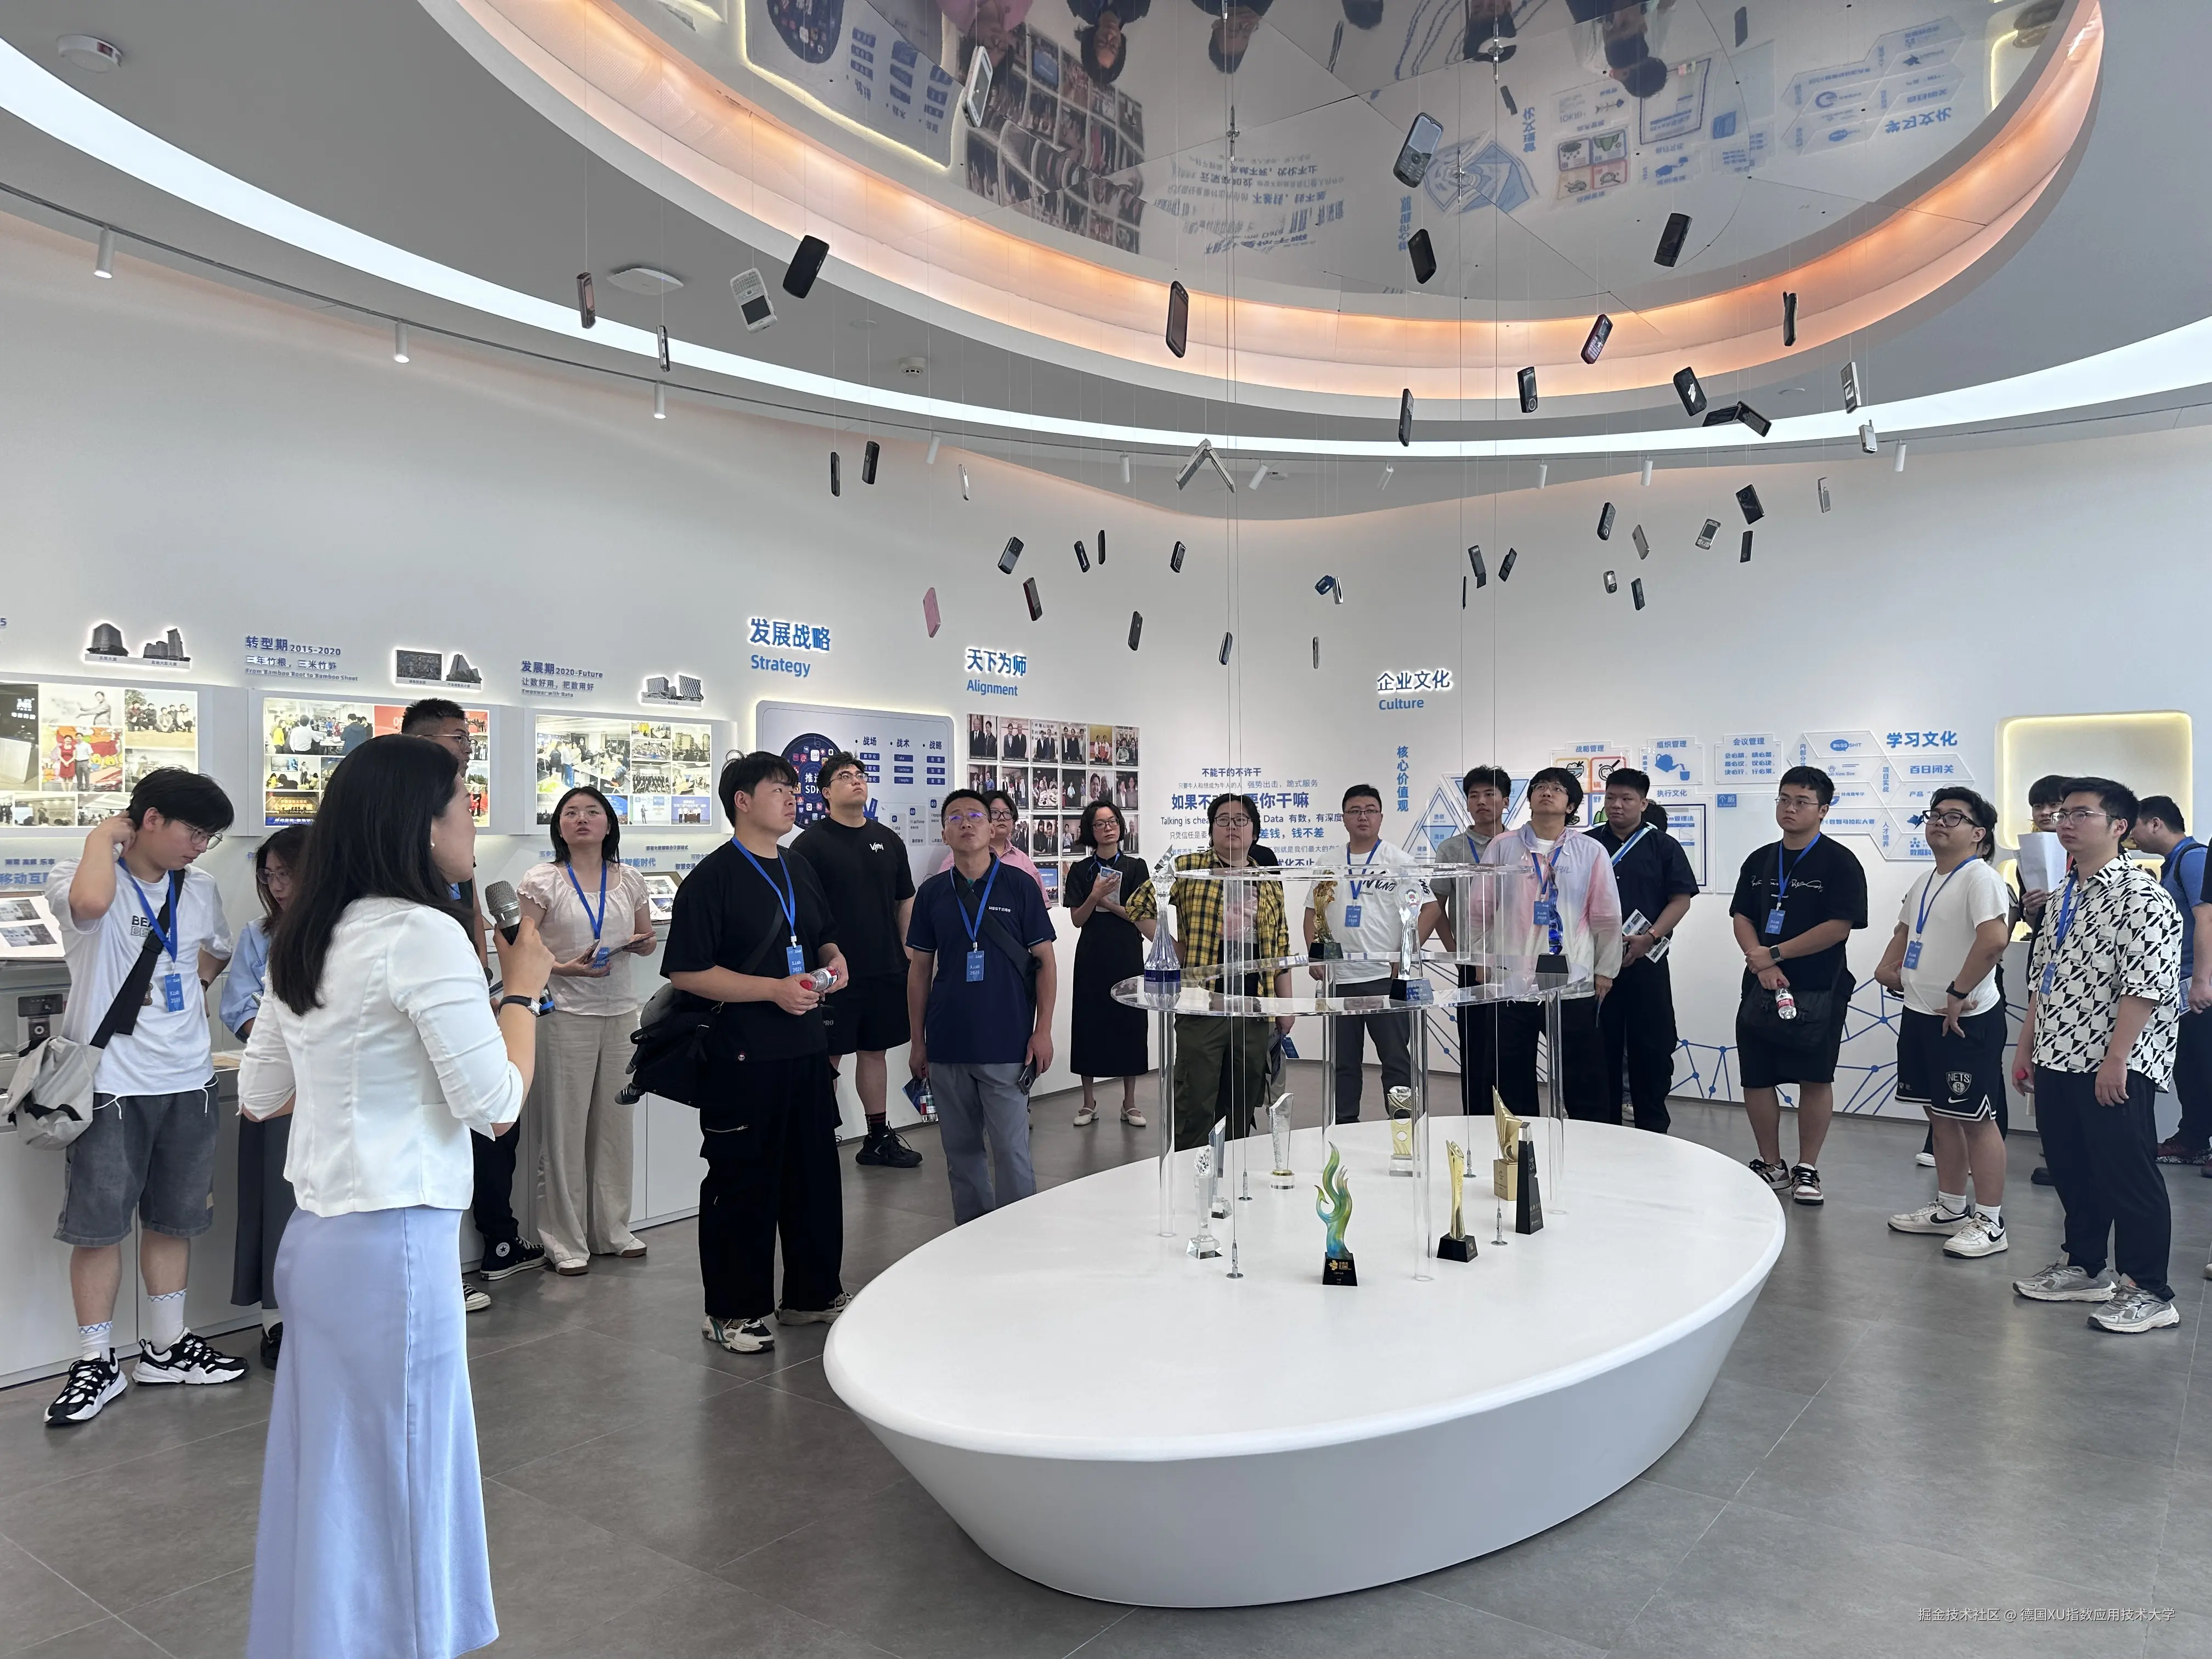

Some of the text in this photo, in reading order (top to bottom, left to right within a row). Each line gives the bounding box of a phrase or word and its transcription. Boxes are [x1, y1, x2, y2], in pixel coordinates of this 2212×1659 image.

[750, 618, 831, 651] 发展战略
[246, 636, 341, 656] 转型期 2015-2020
[751, 654, 811, 678] Strategy
[967, 648, 1027, 676] 天下为师
[521, 661, 603, 678] 发展期 2020-Future
[1377, 670, 1450, 691] 企业文化
[967, 679, 1018, 696] Alignment
[1379, 698, 1424, 710] Culture
[863, 736, 877, 746] 战场
[896, 738, 910, 748] 战术
[929, 741, 942, 749] 战略
[1733, 737, 1765, 746] 会议管理
[1887, 731, 1957, 748] 学习文化
[1201, 768, 1261, 777] 不能干的不许干
[1910, 765, 1954, 774] 百日闭关
[1397, 746, 1409, 812] 核心价值观
[1160, 817, 1183, 826] Talking
[1170, 831, 1211, 839] 只凭信任是要
[1948, 1073, 1970, 1084] NETS
